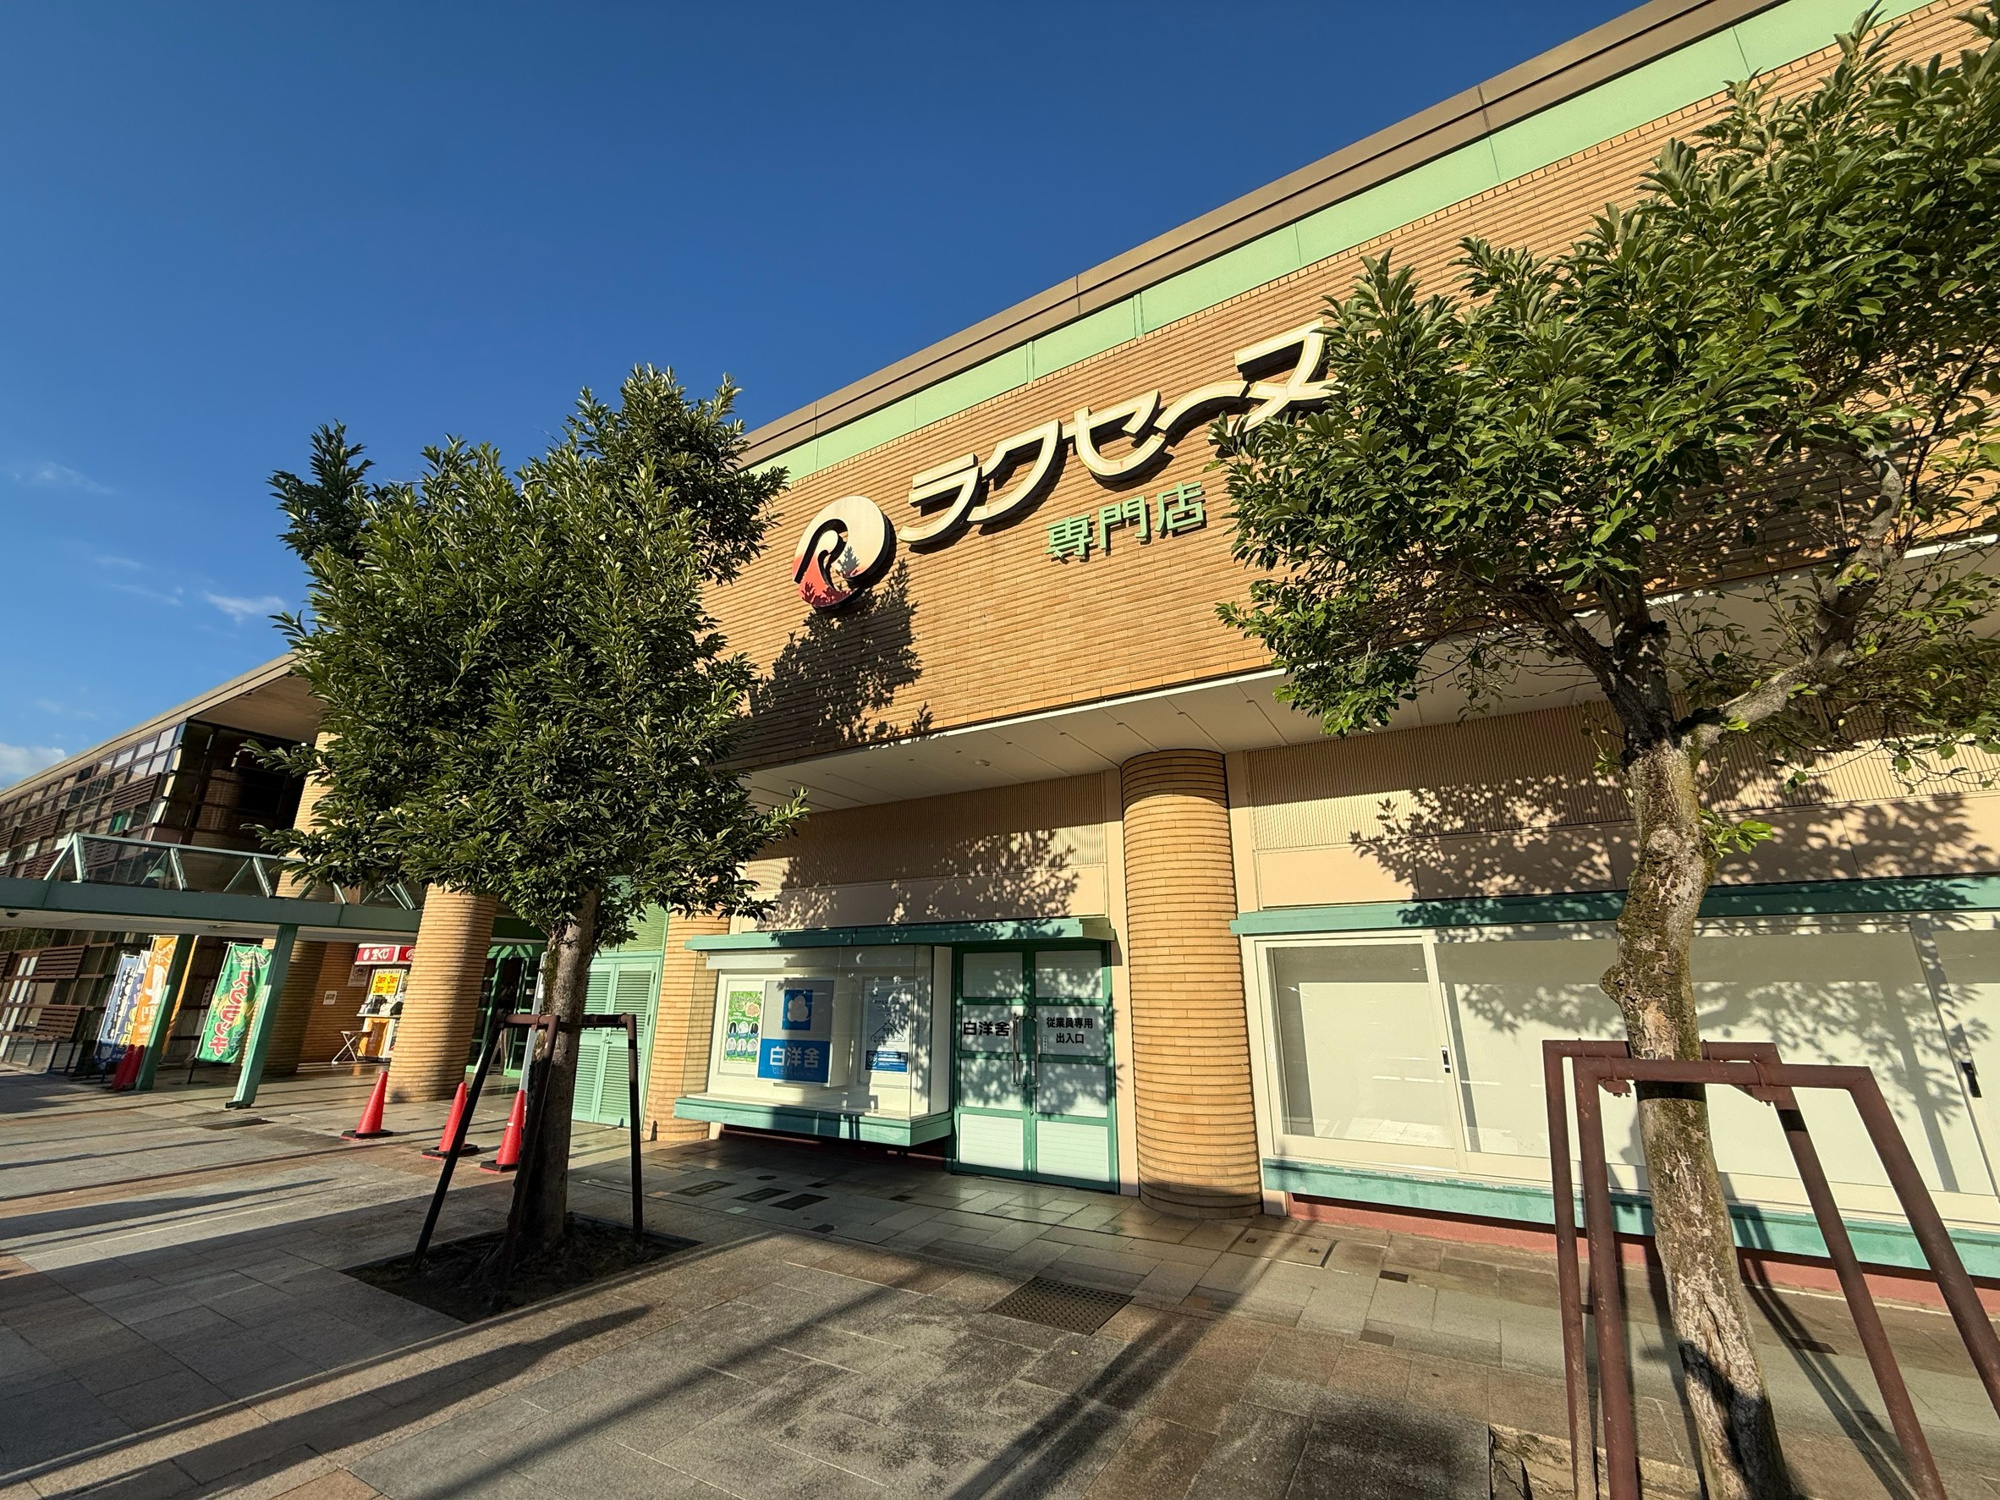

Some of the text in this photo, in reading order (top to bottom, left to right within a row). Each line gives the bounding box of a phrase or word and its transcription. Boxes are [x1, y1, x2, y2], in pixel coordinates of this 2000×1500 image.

[898, 318, 1348, 544] ラクセーヌ
[1045, 481, 1204, 558] 専門店
[1046, 1017, 1093, 1029] 従業員専用
[1056, 1033, 1085, 1044] 出入口
